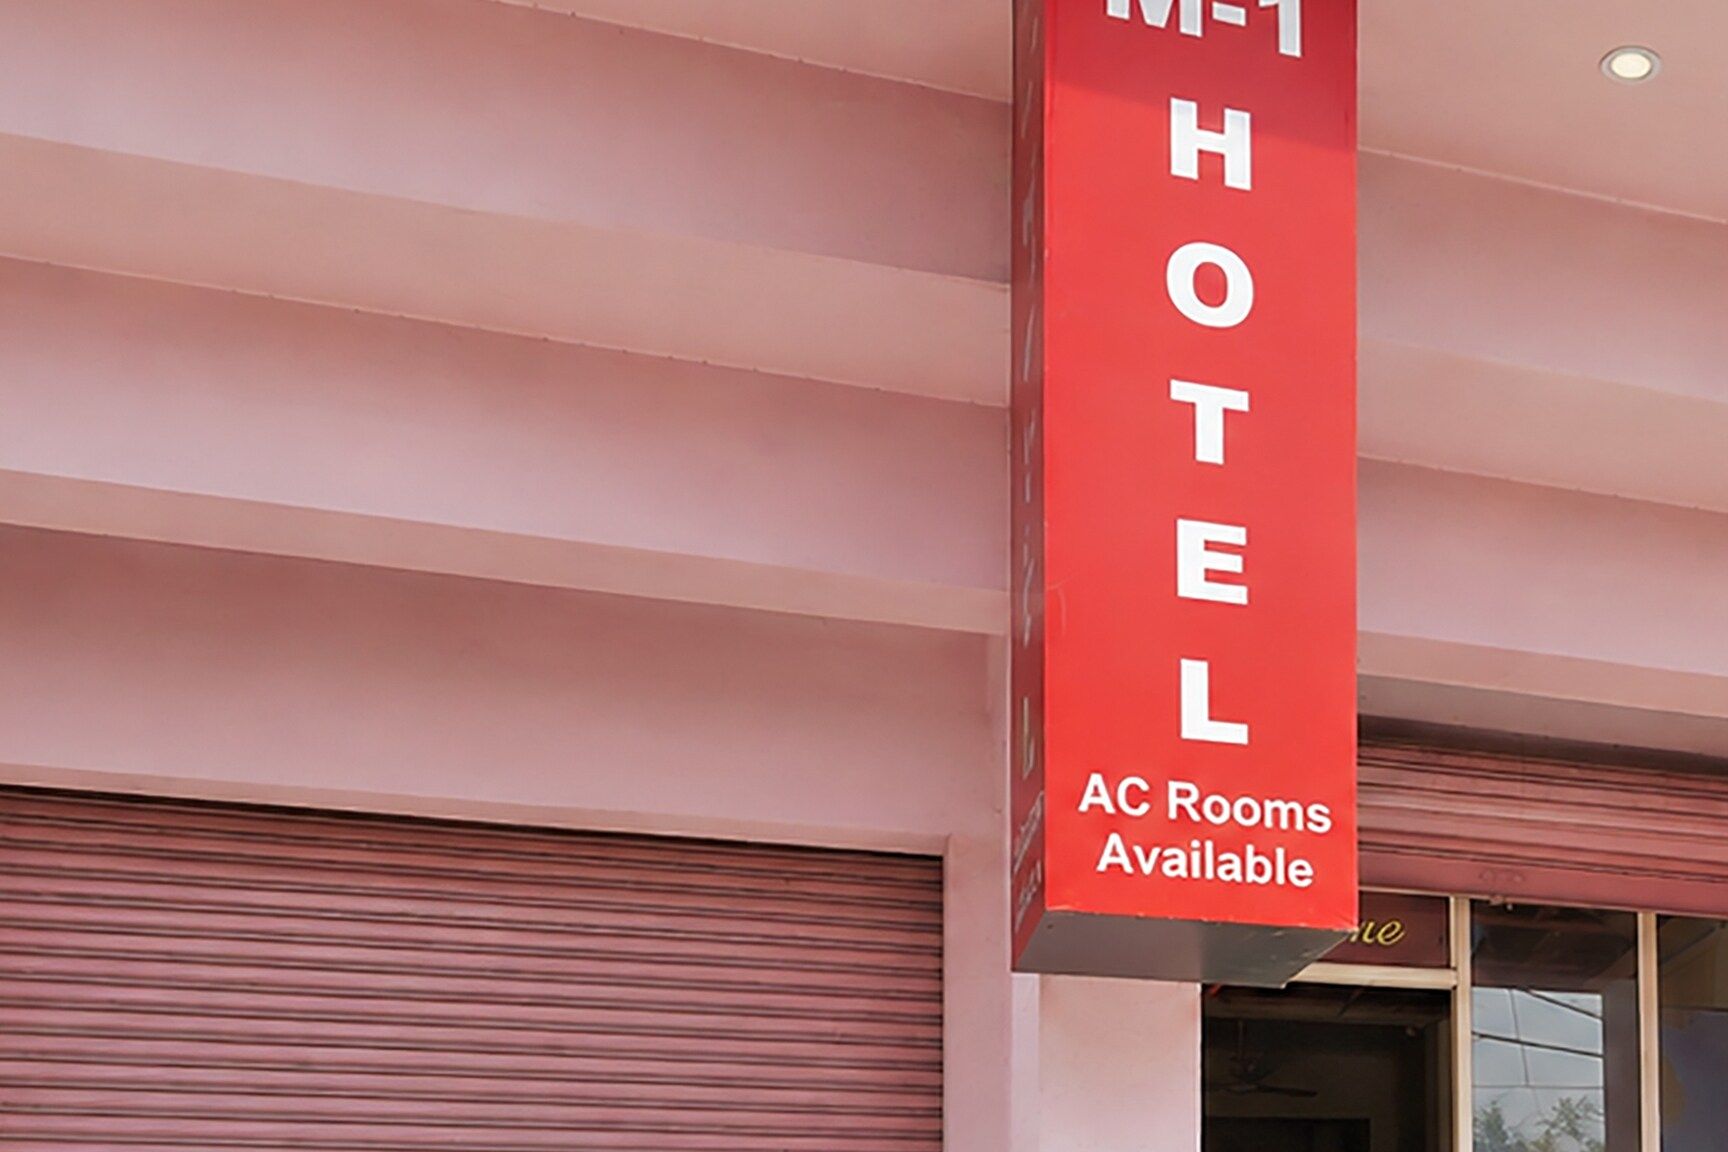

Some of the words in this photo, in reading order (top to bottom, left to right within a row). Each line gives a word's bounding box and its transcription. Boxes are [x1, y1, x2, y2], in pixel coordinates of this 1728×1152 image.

[1166, 97, 1254, 745] HOTEL
[1077, 772, 1151, 817] AC
[1167, 779, 1333, 834] Rooms
[1096, 832, 1314, 888] Available
